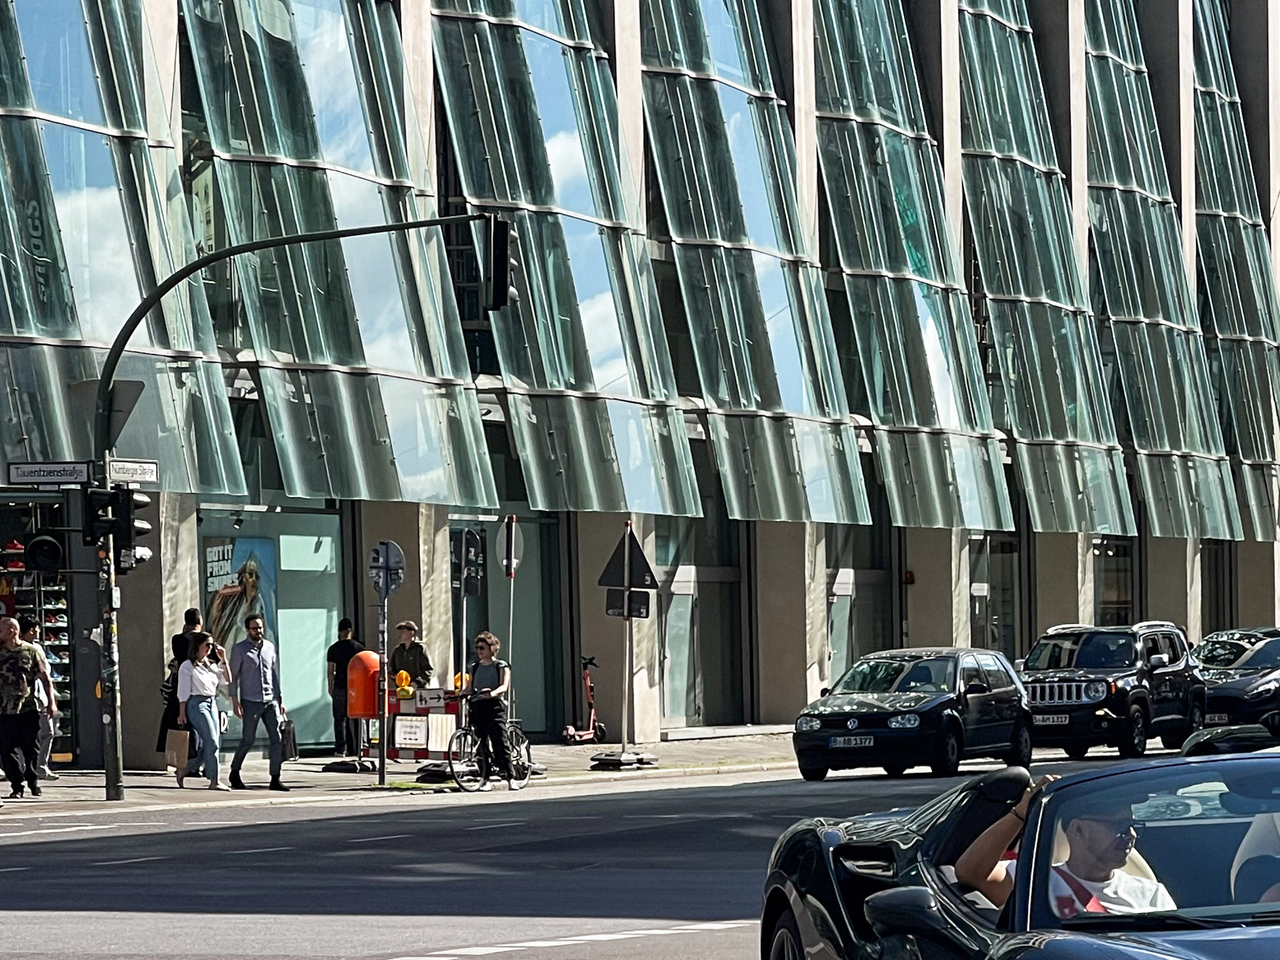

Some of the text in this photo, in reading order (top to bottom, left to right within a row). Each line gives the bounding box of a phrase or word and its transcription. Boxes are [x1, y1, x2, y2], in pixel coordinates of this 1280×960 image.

[207, 545, 233, 562] GOT IT
[207, 560, 231, 577] FROM
